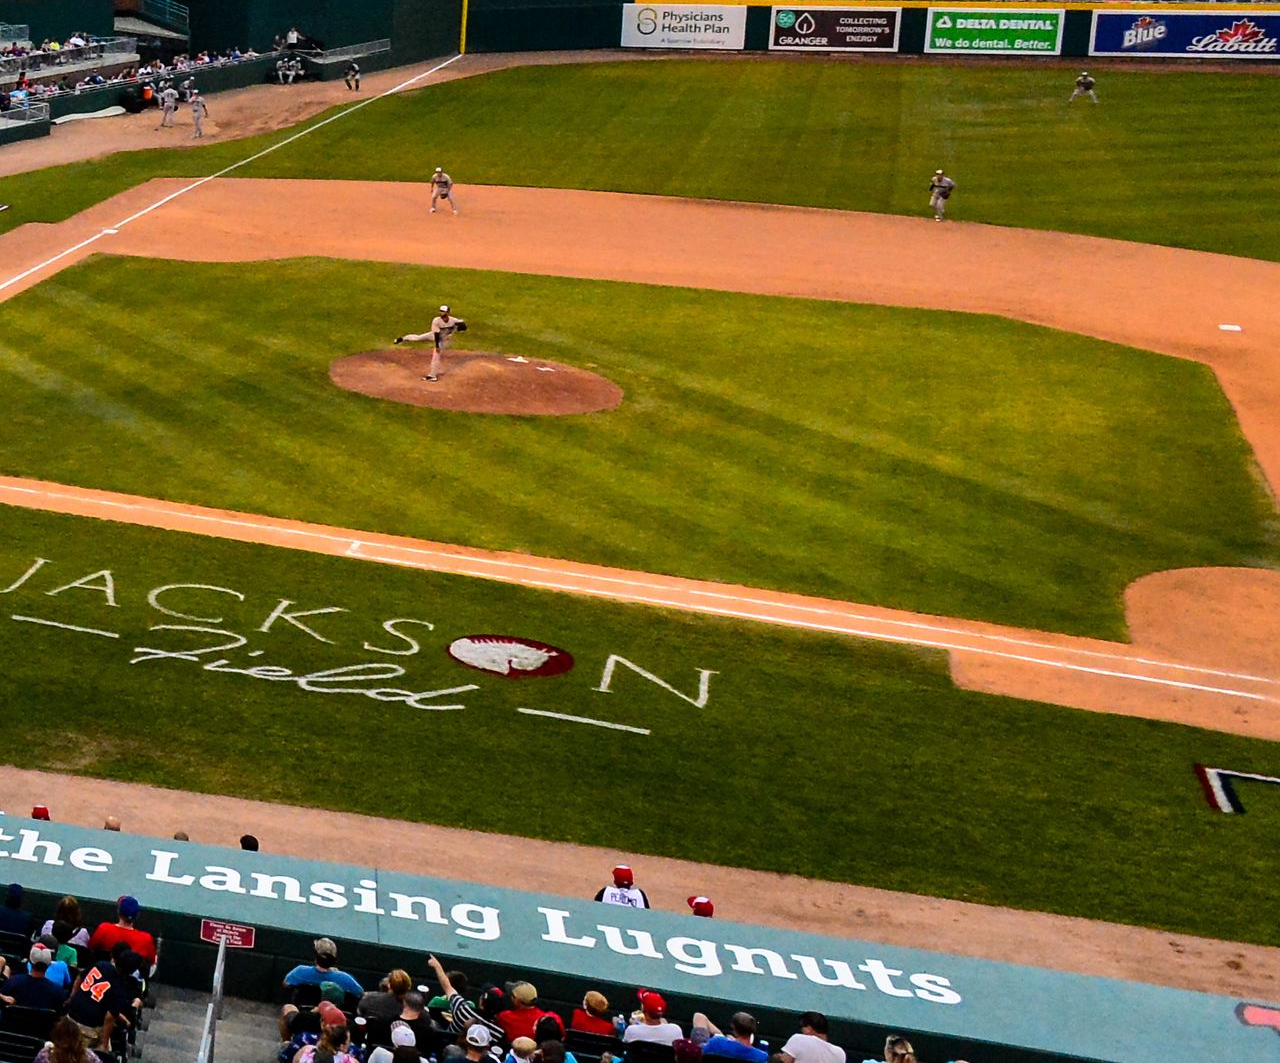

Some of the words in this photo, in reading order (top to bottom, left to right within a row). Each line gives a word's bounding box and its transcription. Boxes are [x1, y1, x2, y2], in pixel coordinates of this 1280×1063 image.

[662, 11, 724, 23] Physicians
[661, 23, 701, 33] Health
[704, 24, 730, 34] Plan
[836, 26, 890, 34] TOMORROW'S
[956, 19, 997, 29] DELTA
[999, 20, 1054, 30] DENTAL
[779, 36, 828, 45] GRANGER
[846, 35, 878, 43] ENERGY
[1122, 25, 1167, 47] Blue
[935, 38, 952, 47] We
[955, 38, 970, 48] do
[972, 38, 1012, 48] dental.
[1014, 39, 1052, 49] Better.
[1186, 35, 1277, 52] Labatt
[129, 624, 481, 712] Field
[145, 849, 500, 941] Lansing
[538, 906, 962, 1005] Lugnuts
[80, 966, 111, 1003] 54
